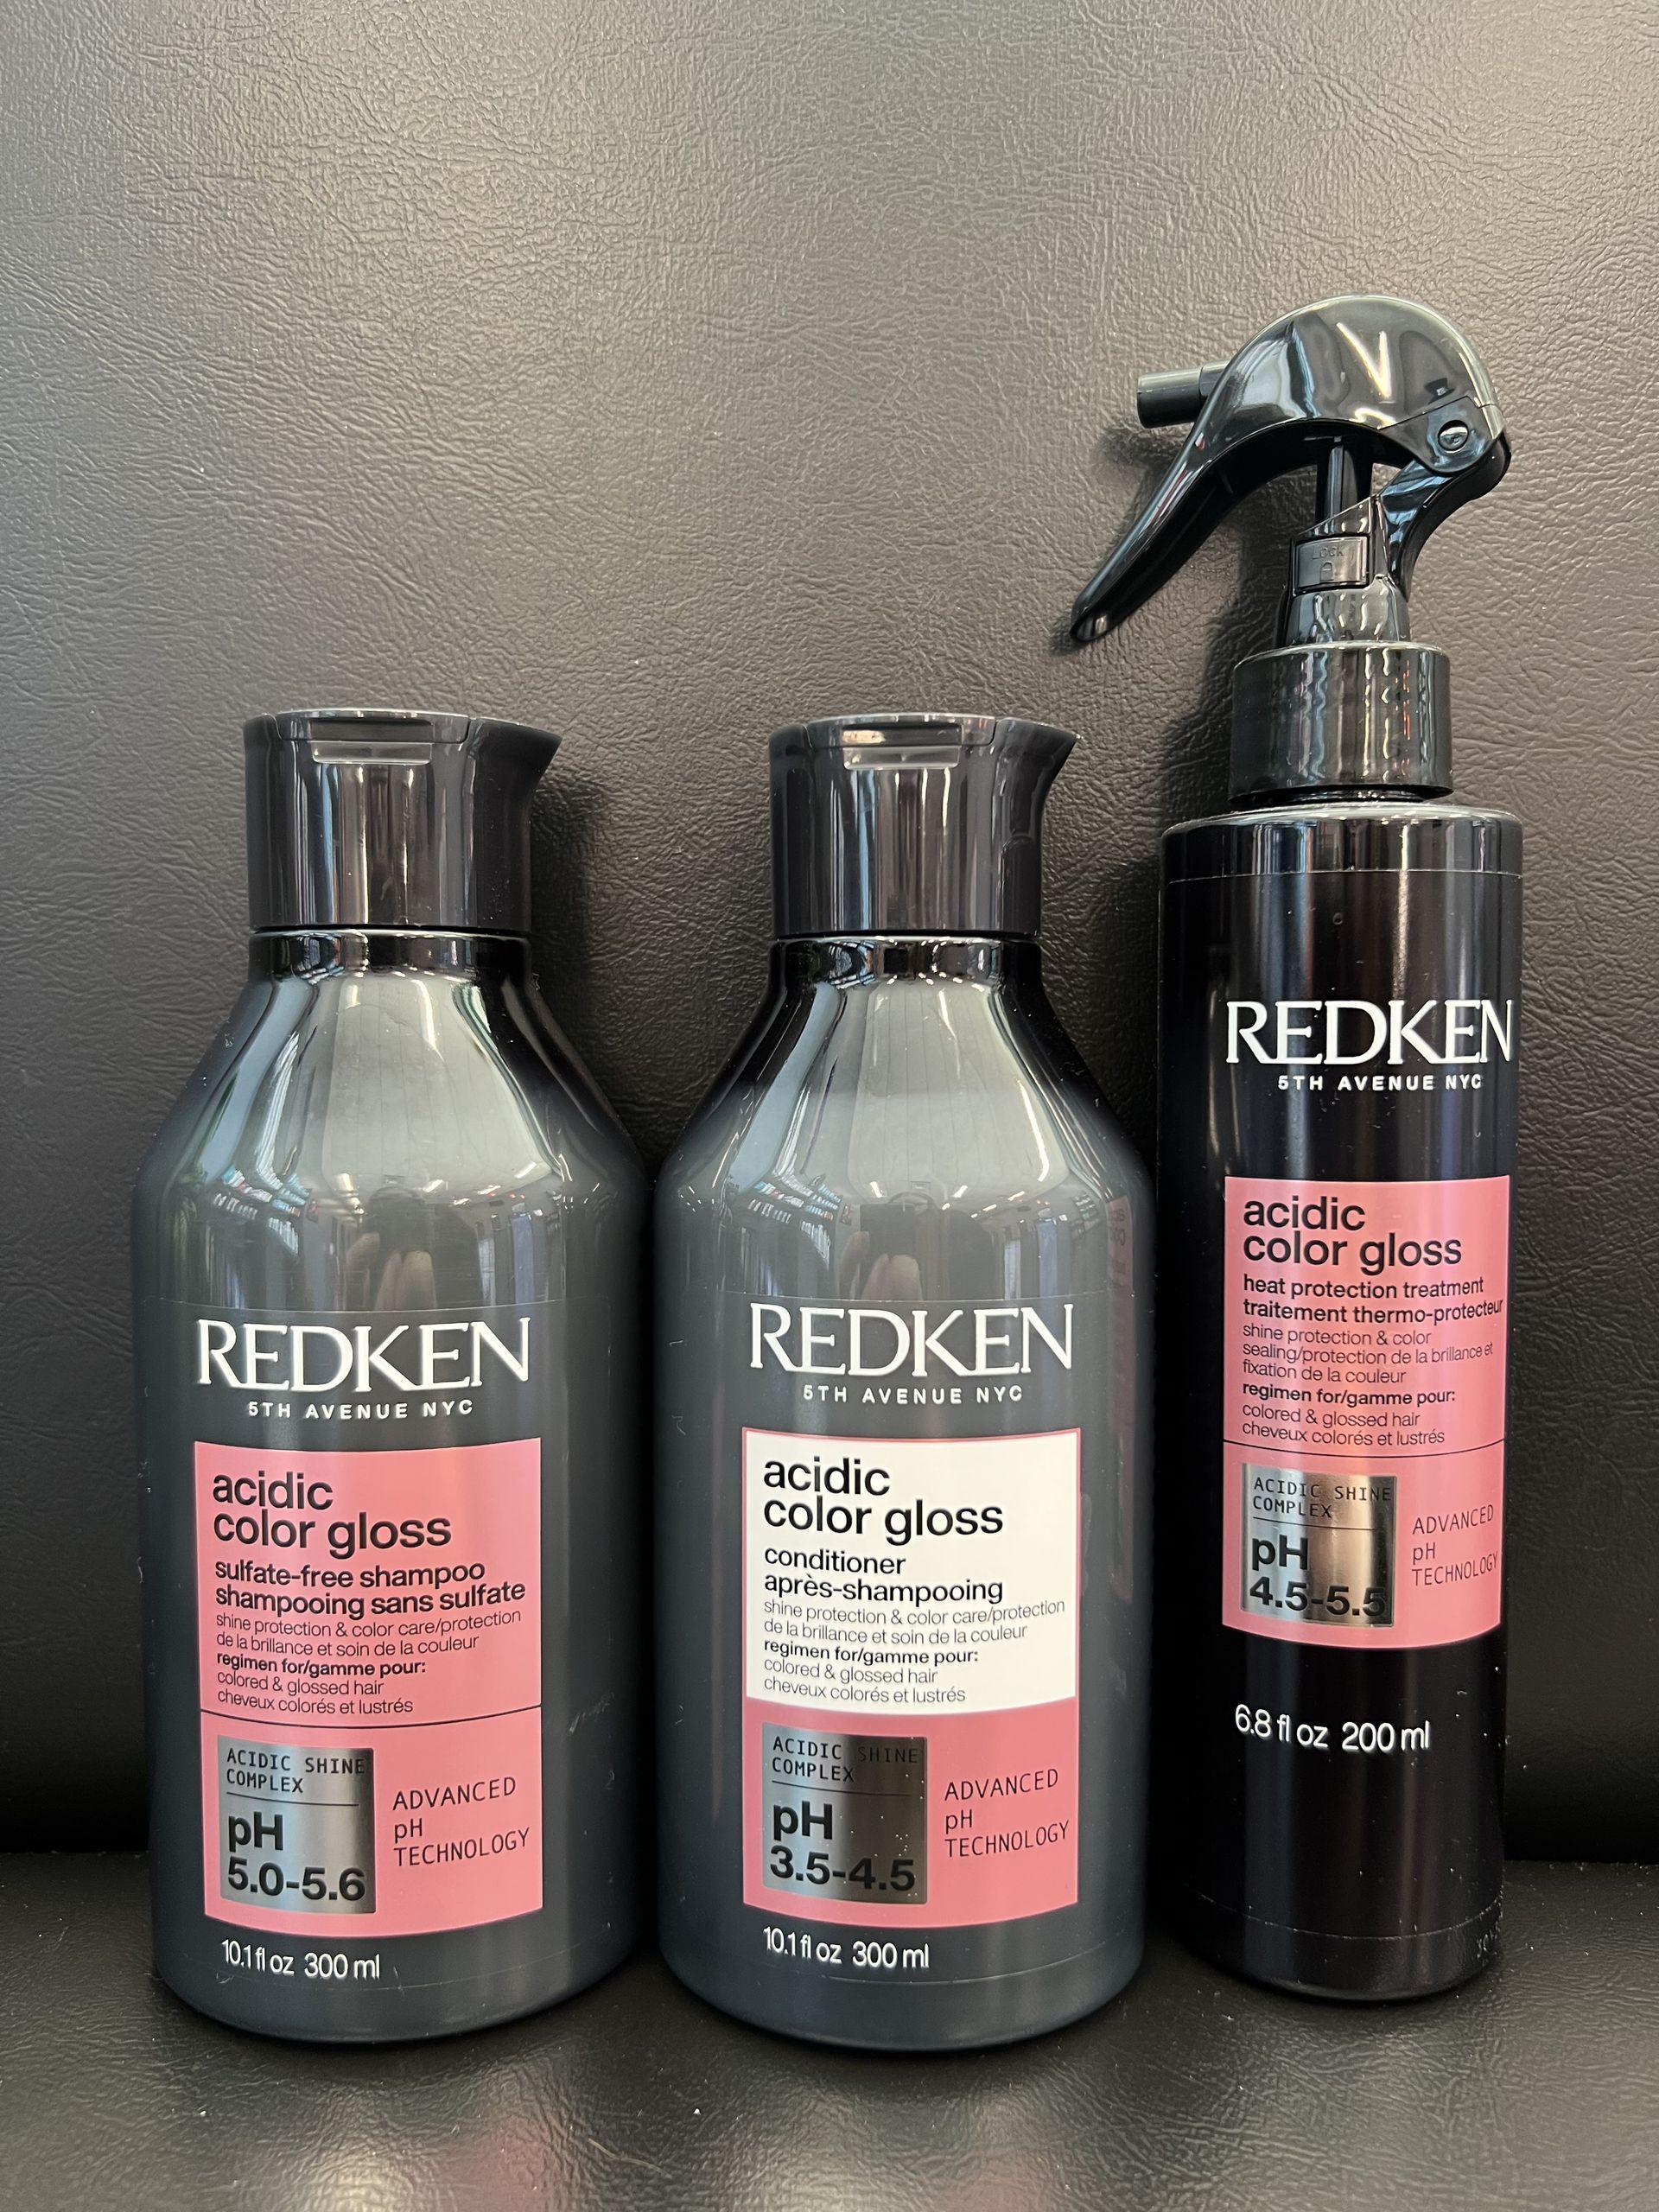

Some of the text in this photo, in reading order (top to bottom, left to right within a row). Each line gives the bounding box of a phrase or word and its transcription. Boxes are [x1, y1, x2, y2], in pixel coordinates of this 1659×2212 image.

[1226, 1000, 1512, 1065] REDKEN
[1278, 1074, 1481, 1090] 5TH AVENUE NYC
[1243, 1195, 1365, 1230] acidic
[1243, 1230, 1462, 1275] color gloss
[1243, 1274, 1484, 1298] heat protection treatment
[1243, 1298, 1503, 1325] traitement thermo-protecteur
[750, 1303, 1073, 1376] REDKEN
[1243, 1325, 1431, 1345] shine protection & color
[197, 1317, 531, 1392] REDKEN
[1243, 1343, 1493, 1364] sealing/protection de la brillance et
[1243, 1361, 1406, 1382] fixation de la couleur
[804, 1385, 1023, 1404] 5TH AVENUE NYC
[1243, 1383, 1455, 1408] regimen for/gamme pour:
[249, 1399, 474, 1420] 5TH AVENUE NYC
[1243, 1404, 1420, 1428] colored & glossed hair
[1243, 1422, 1445, 1446] cheveux colorés et lustrés
[764, 1456, 890, 1496] acidic
[1255, 1478, 1392, 1501] ACIDIC SHINE
[213, 1471, 333, 1510] acidic
[1253, 1496, 1332, 1517] COMPLEX
[1413, 1504, 1494, 1535] ADVANCED
[213, 1510, 451, 1559] color gloss
[764, 1496, 1003, 1546] color gloss
[765, 1548, 906, 1574] conditioner
[1252, 1535, 1308, 1571] pH
[1413, 1542, 1435, 1565] pH
[216, 1560, 485, 1590] sulfate-free shampoo
[1412, 1552, 1497, 1586] TECHNOLOGY
[216, 1580, 526, 1620] shampooing sans sulfate
[765, 1574, 1002, 1607] après-shampooing
[1250, 1577, 1385, 1617] 4.5-5.5
[217, 1609, 521, 1637] shine protection & color care/protection
[764, 1599, 1065, 1625] shine protection & color care/protection
[217, 1633, 479, 1656] de la brillance et soin de la couleur
[764, 1618, 1027, 1644] de la brillance et soin de la couleur
[218, 1653, 426, 1677] regimen for/gamme pour:
[765, 1641, 978, 1666] regimen for/gamme pour:
[218, 1671, 384, 1698] colored & glossed hair
[764, 1658, 938, 1685] colored & glossed hair
[218, 1690, 413, 1714] cheveux colorés et lustrés
[764, 1677, 966, 1702] cheveux colorés et lustrés
[1236, 1704, 1429, 1751] 6.8 fl oz 200 ml
[226, 1748, 365, 1774] ACIDIC SHINE
[772, 1736, 918, 1764] ACIDIC SHINE
[226, 1770, 303, 1793] COMPLEX
[772, 1758, 855, 1783] COMPLEX
[392, 1777, 516, 1810] ADVANCED
[944, 1769, 1058, 1802] ADVANCED
[229, 1812, 283, 1852] pH
[394, 1818, 423, 1843] pH
[773, 1801, 833, 1841] pH
[945, 1809, 973, 1834] pH
[394, 1827, 530, 1866] TECHNOLOGY
[944, 1819, 1070, 1858] TECHNOLOGY
[228, 1857, 365, 1901] 5.0-5.6
[770, 1846, 915, 1891] 3.5-4.5
[221, 1940, 380, 1979] 10.1 fl oz 300 ml
[764, 1926, 930, 1968] 10.1 fl oz 300 ml
